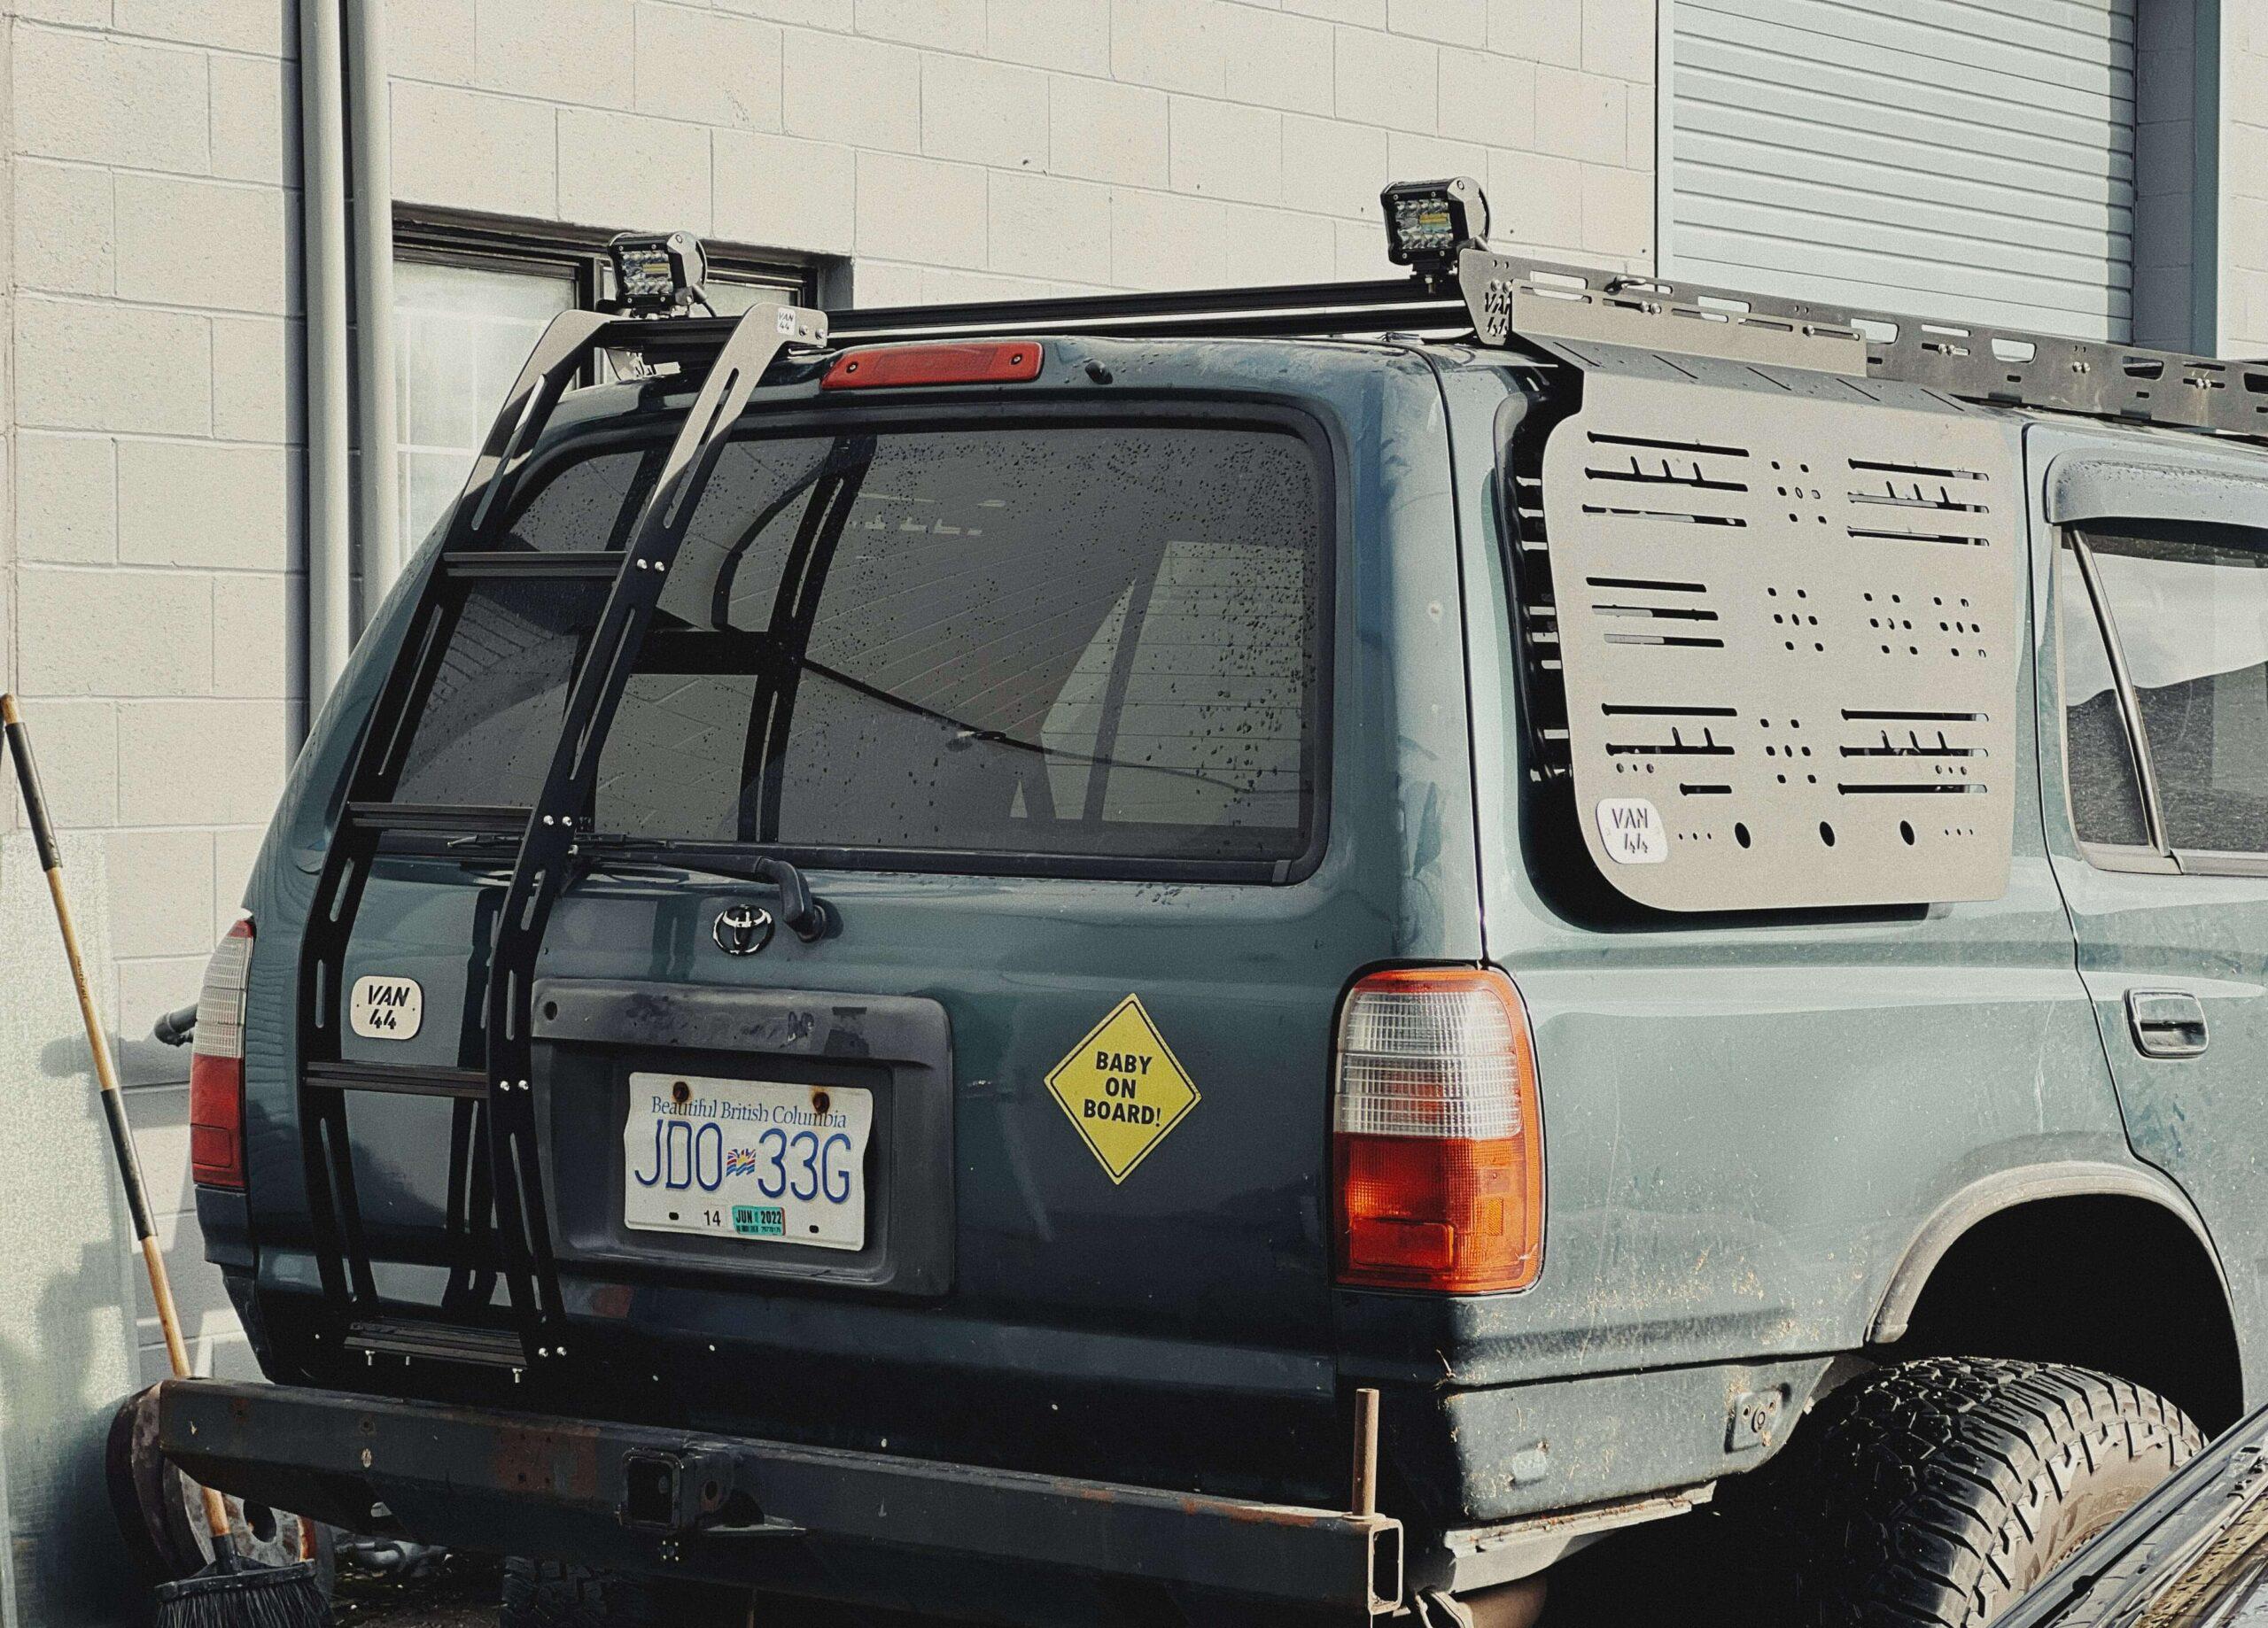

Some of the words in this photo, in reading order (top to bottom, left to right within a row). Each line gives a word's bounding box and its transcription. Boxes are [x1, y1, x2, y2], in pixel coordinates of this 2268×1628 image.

[779, 312, 794, 322] VAN
[780, 322, 789, 330] 44
[1612, 807, 1648, 829] VAN
[1624, 833, 1648, 854] 44
[368, 984, 410, 1007] VAN
[369, 1008, 397, 1030] 44
[1095, 1050, 1153, 1075] BABY
[1105, 1077, 1137, 1099] ON
[652, 1096, 718, 1119] Beautiful
[721, 1101, 769, 1123] British
[773, 1105, 847, 1128] Columbia
[1084, 1098, 1161, 1128] BOARD!
[757, 1128, 851, 1205] 33G
[703, 1210, 721, 1227] 14
[735, 1209, 753, 1224] JUN
[760, 1210, 782, 1225] 2022
